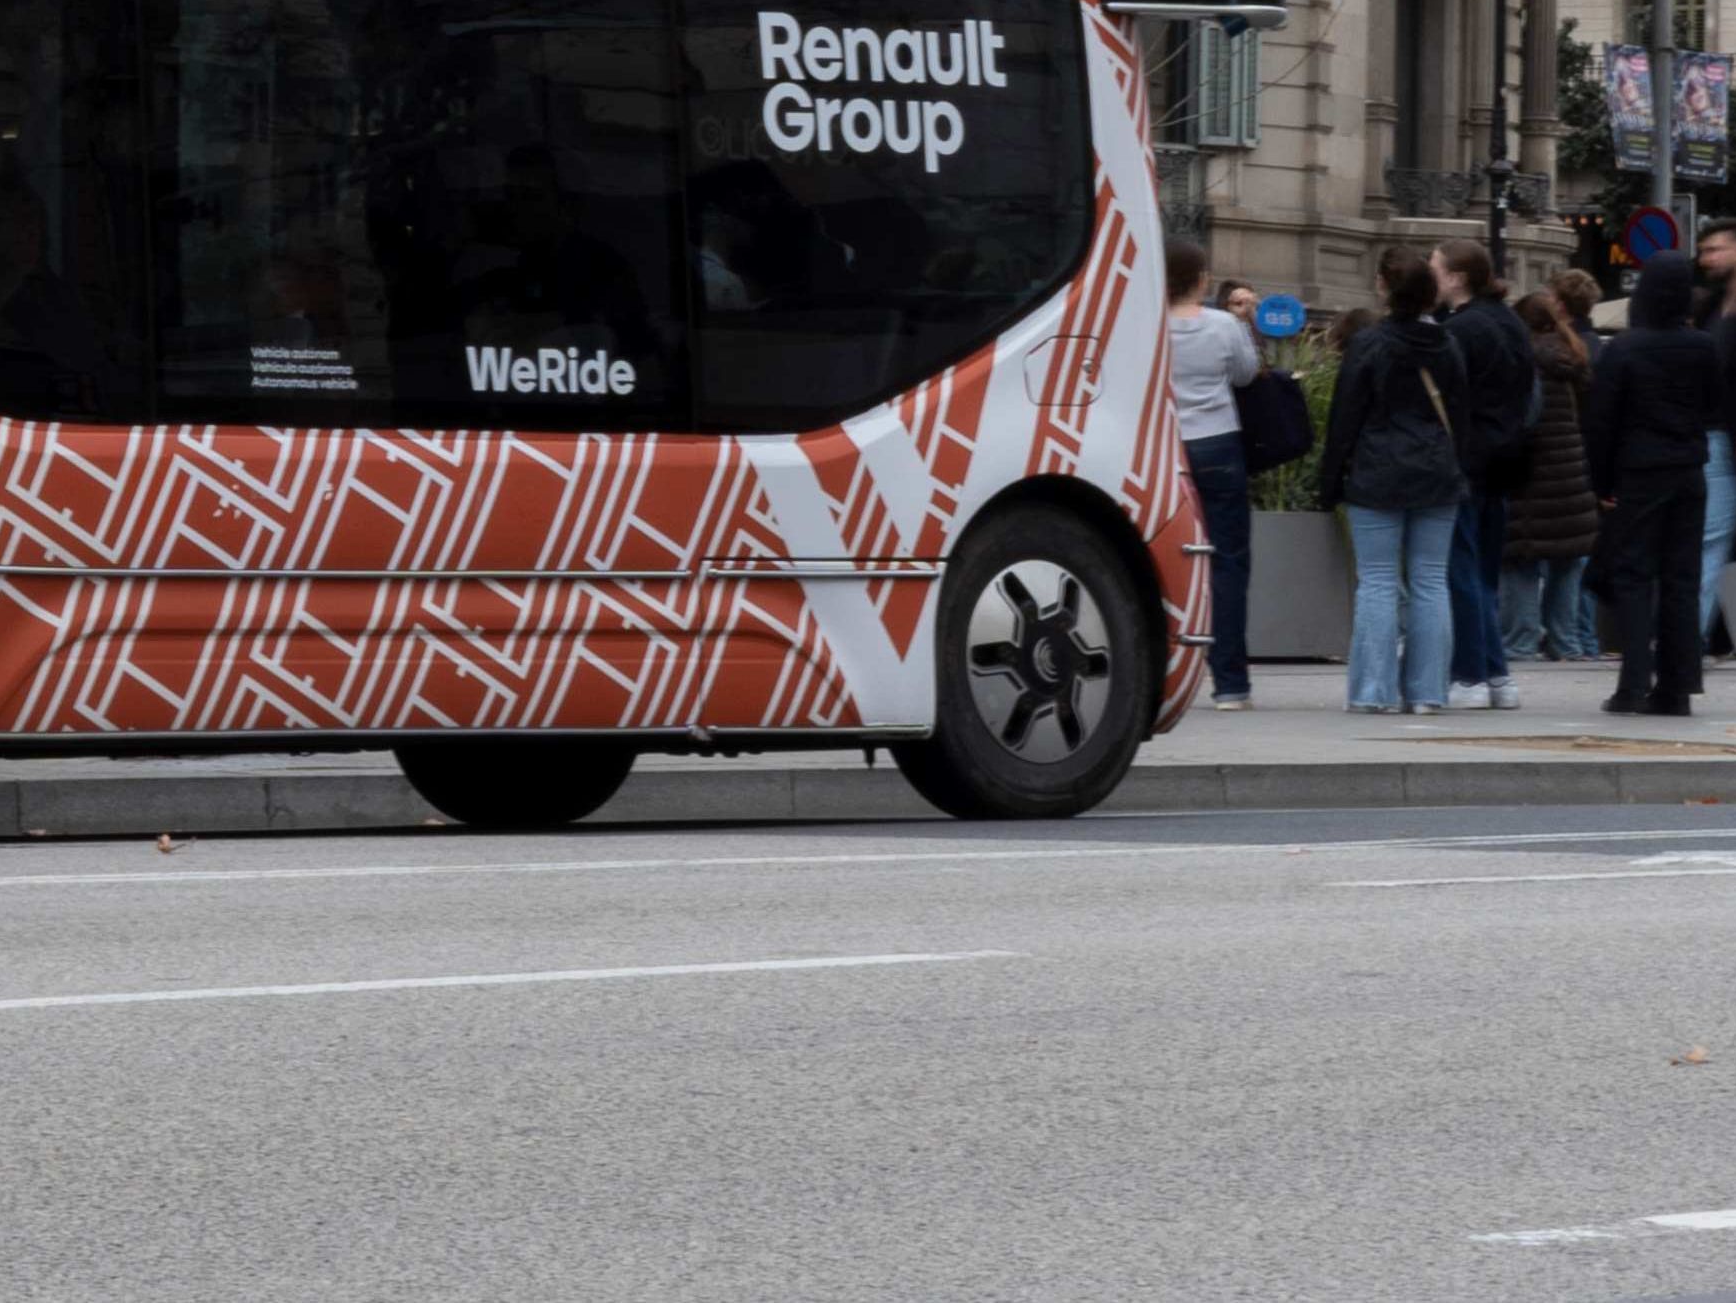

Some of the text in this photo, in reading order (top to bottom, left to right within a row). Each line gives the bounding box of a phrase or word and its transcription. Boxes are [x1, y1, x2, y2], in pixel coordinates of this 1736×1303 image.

[758, 11, 1007, 87] Renault
[763, 82, 964, 173] Group
[466, 346, 635, 395] WeRide
